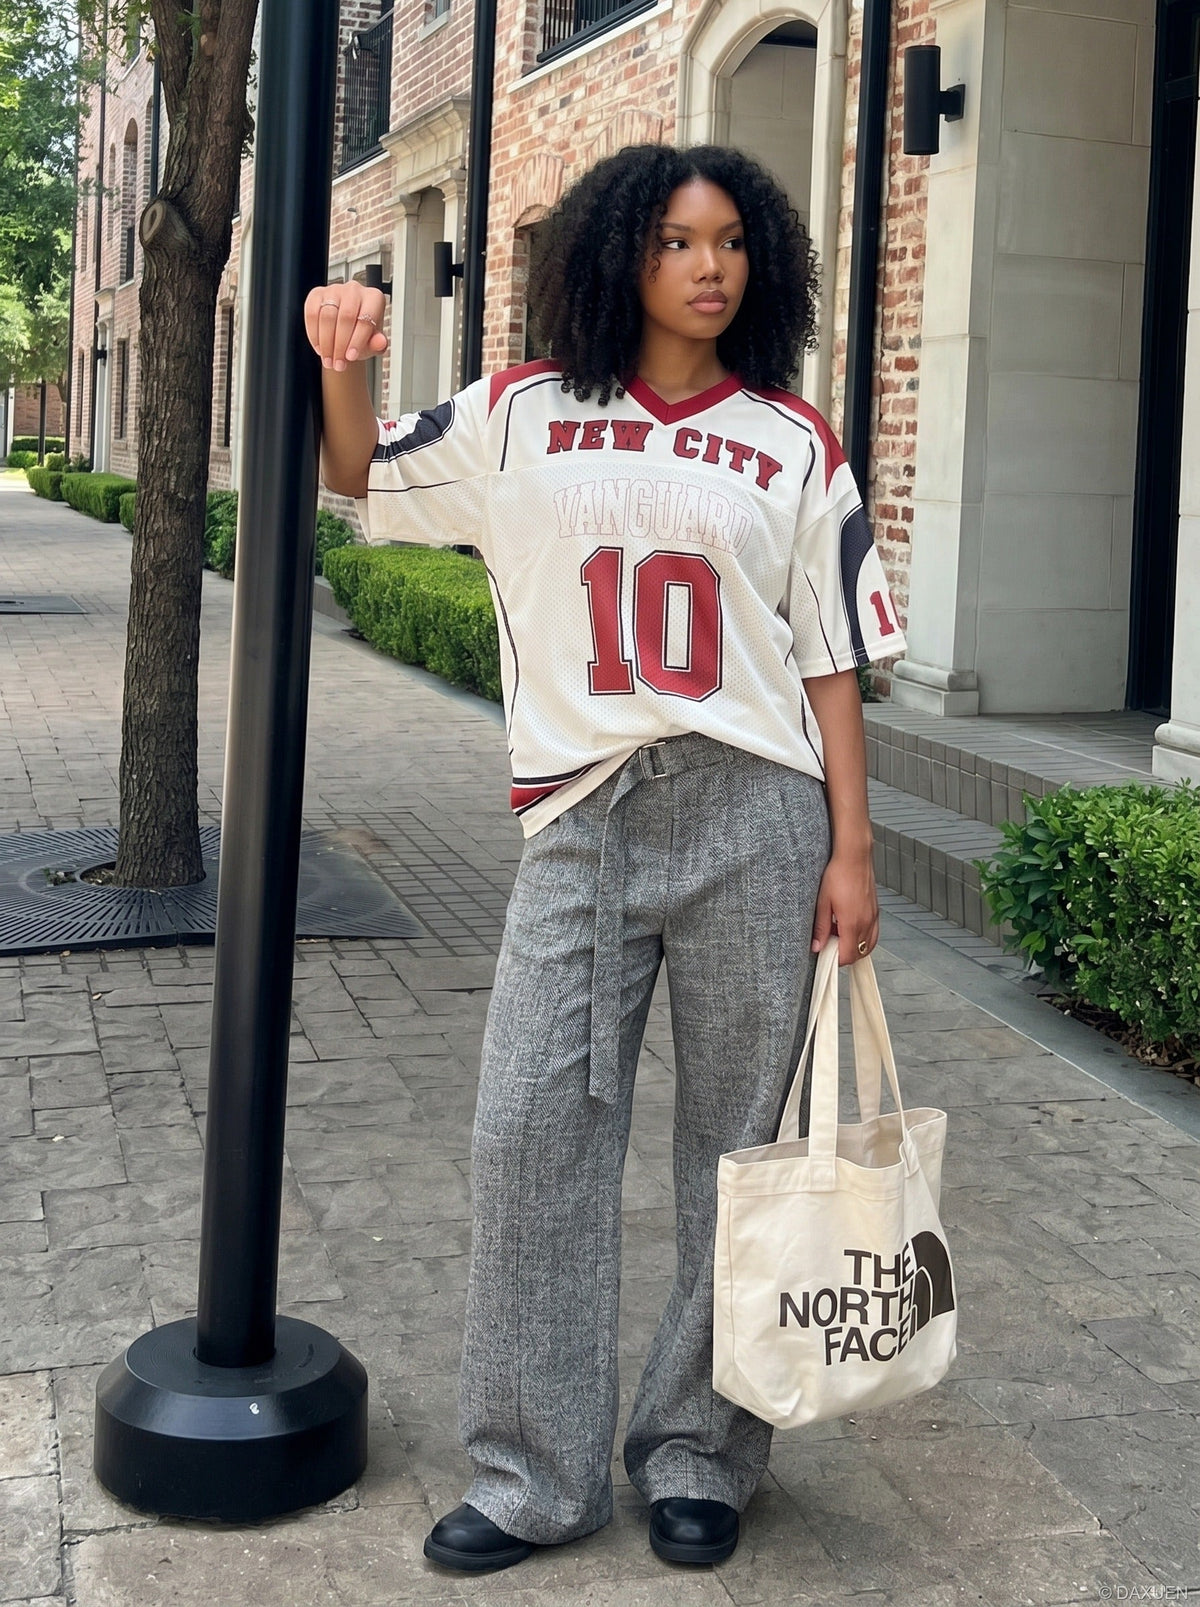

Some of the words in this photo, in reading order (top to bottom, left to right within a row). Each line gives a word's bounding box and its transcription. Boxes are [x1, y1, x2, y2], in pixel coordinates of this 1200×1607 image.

[547, 420, 653, 454] NEW
[673, 427, 783, 491] CITY
[554, 478, 754, 557] VANGUARD
[580, 545, 723, 703] 10
[869, 590, 901, 637] 1
[843, 1241, 915, 1288] THE
[779, 1276, 914, 1329] NORTH
[824, 1313, 911, 1366] FACE
